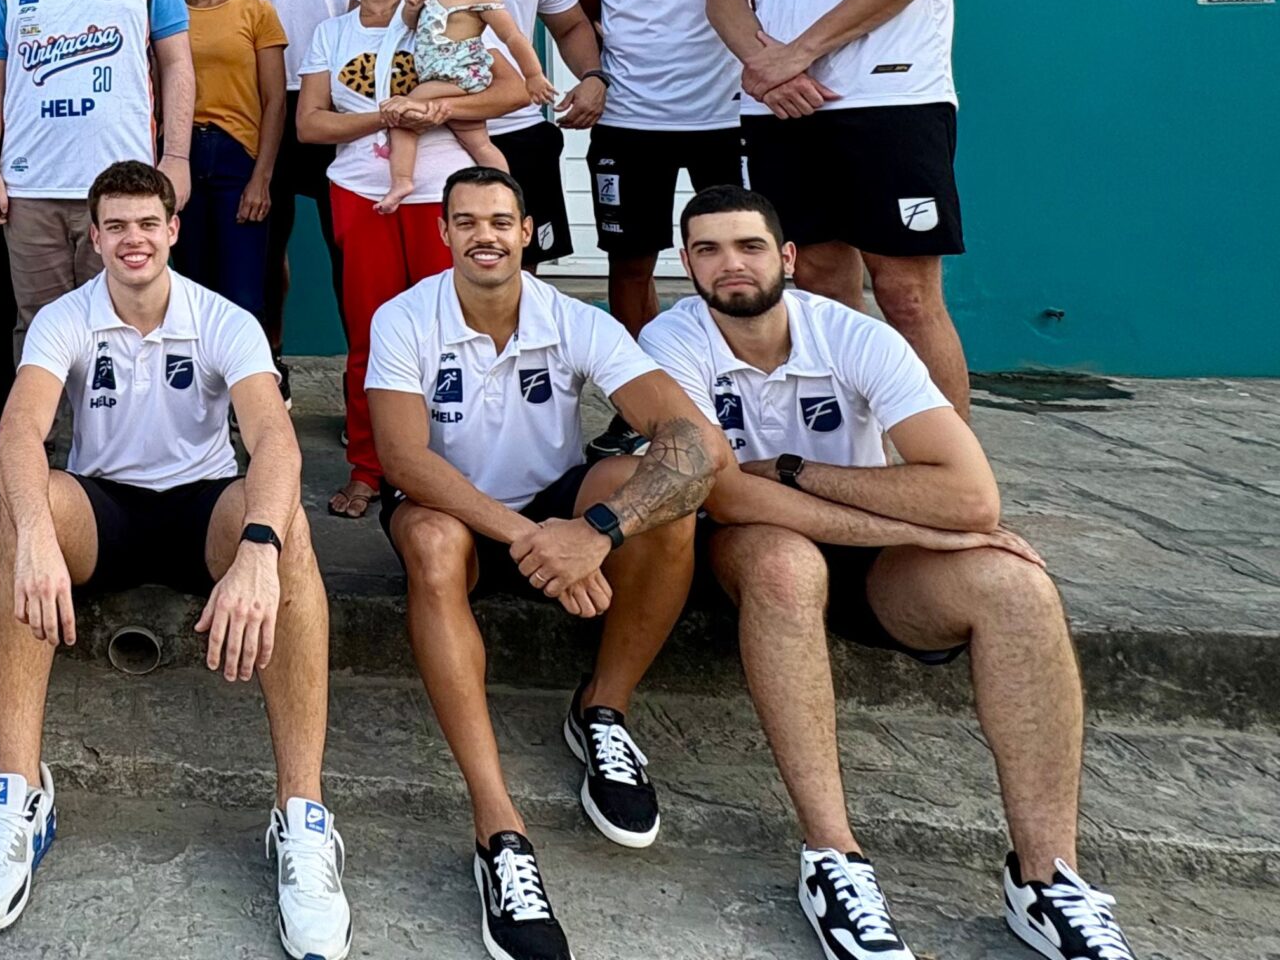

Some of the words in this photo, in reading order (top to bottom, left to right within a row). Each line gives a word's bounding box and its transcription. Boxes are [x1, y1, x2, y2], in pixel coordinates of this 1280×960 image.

[18, 25, 121, 71] Unifacisa
[92, 66, 113, 93] 20
[40, 98, 96, 119] HELP
[90, 396, 117, 408] HELP
[431, 409, 463, 423] HELP
